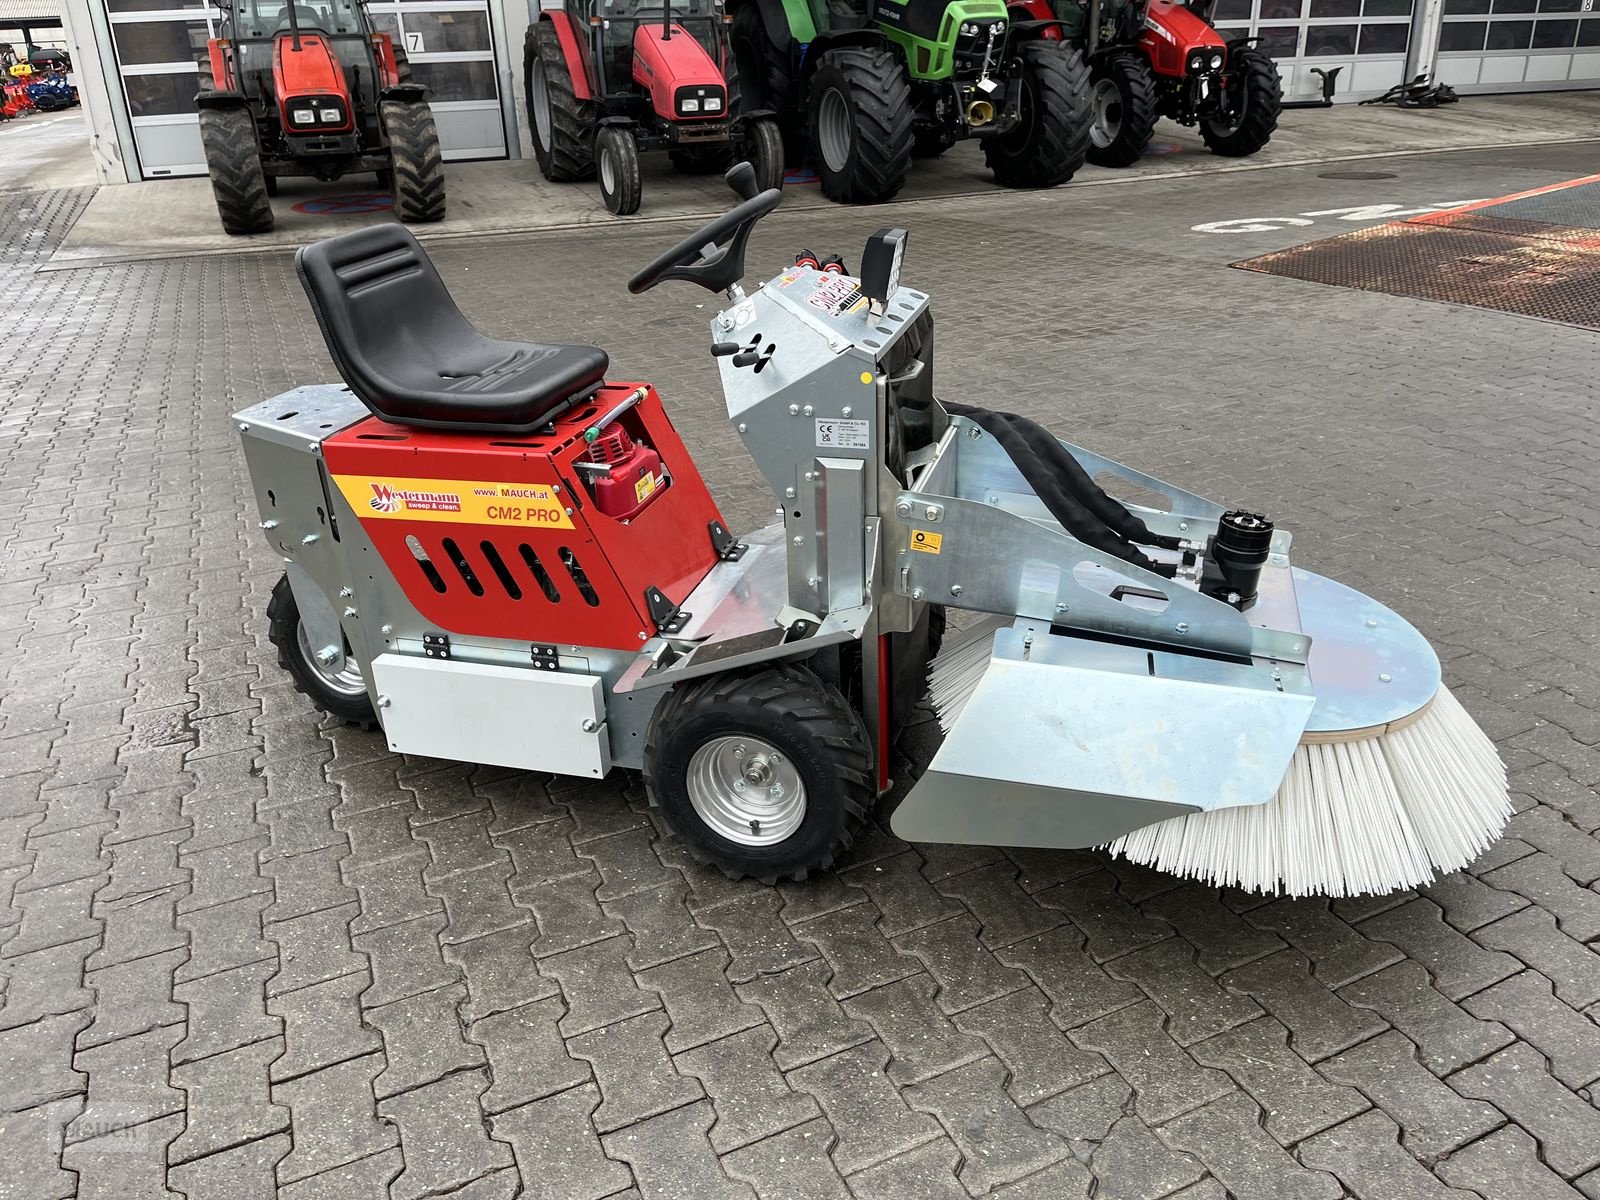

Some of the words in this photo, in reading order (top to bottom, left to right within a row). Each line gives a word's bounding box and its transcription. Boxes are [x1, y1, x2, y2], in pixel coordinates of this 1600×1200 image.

[409, 35, 419, 51] 7
[370, 483, 460, 504] Westermann
[408, 502, 430, 510] sweep
[487, 505, 522, 520] CM2
[526, 508, 561, 522] PRO
